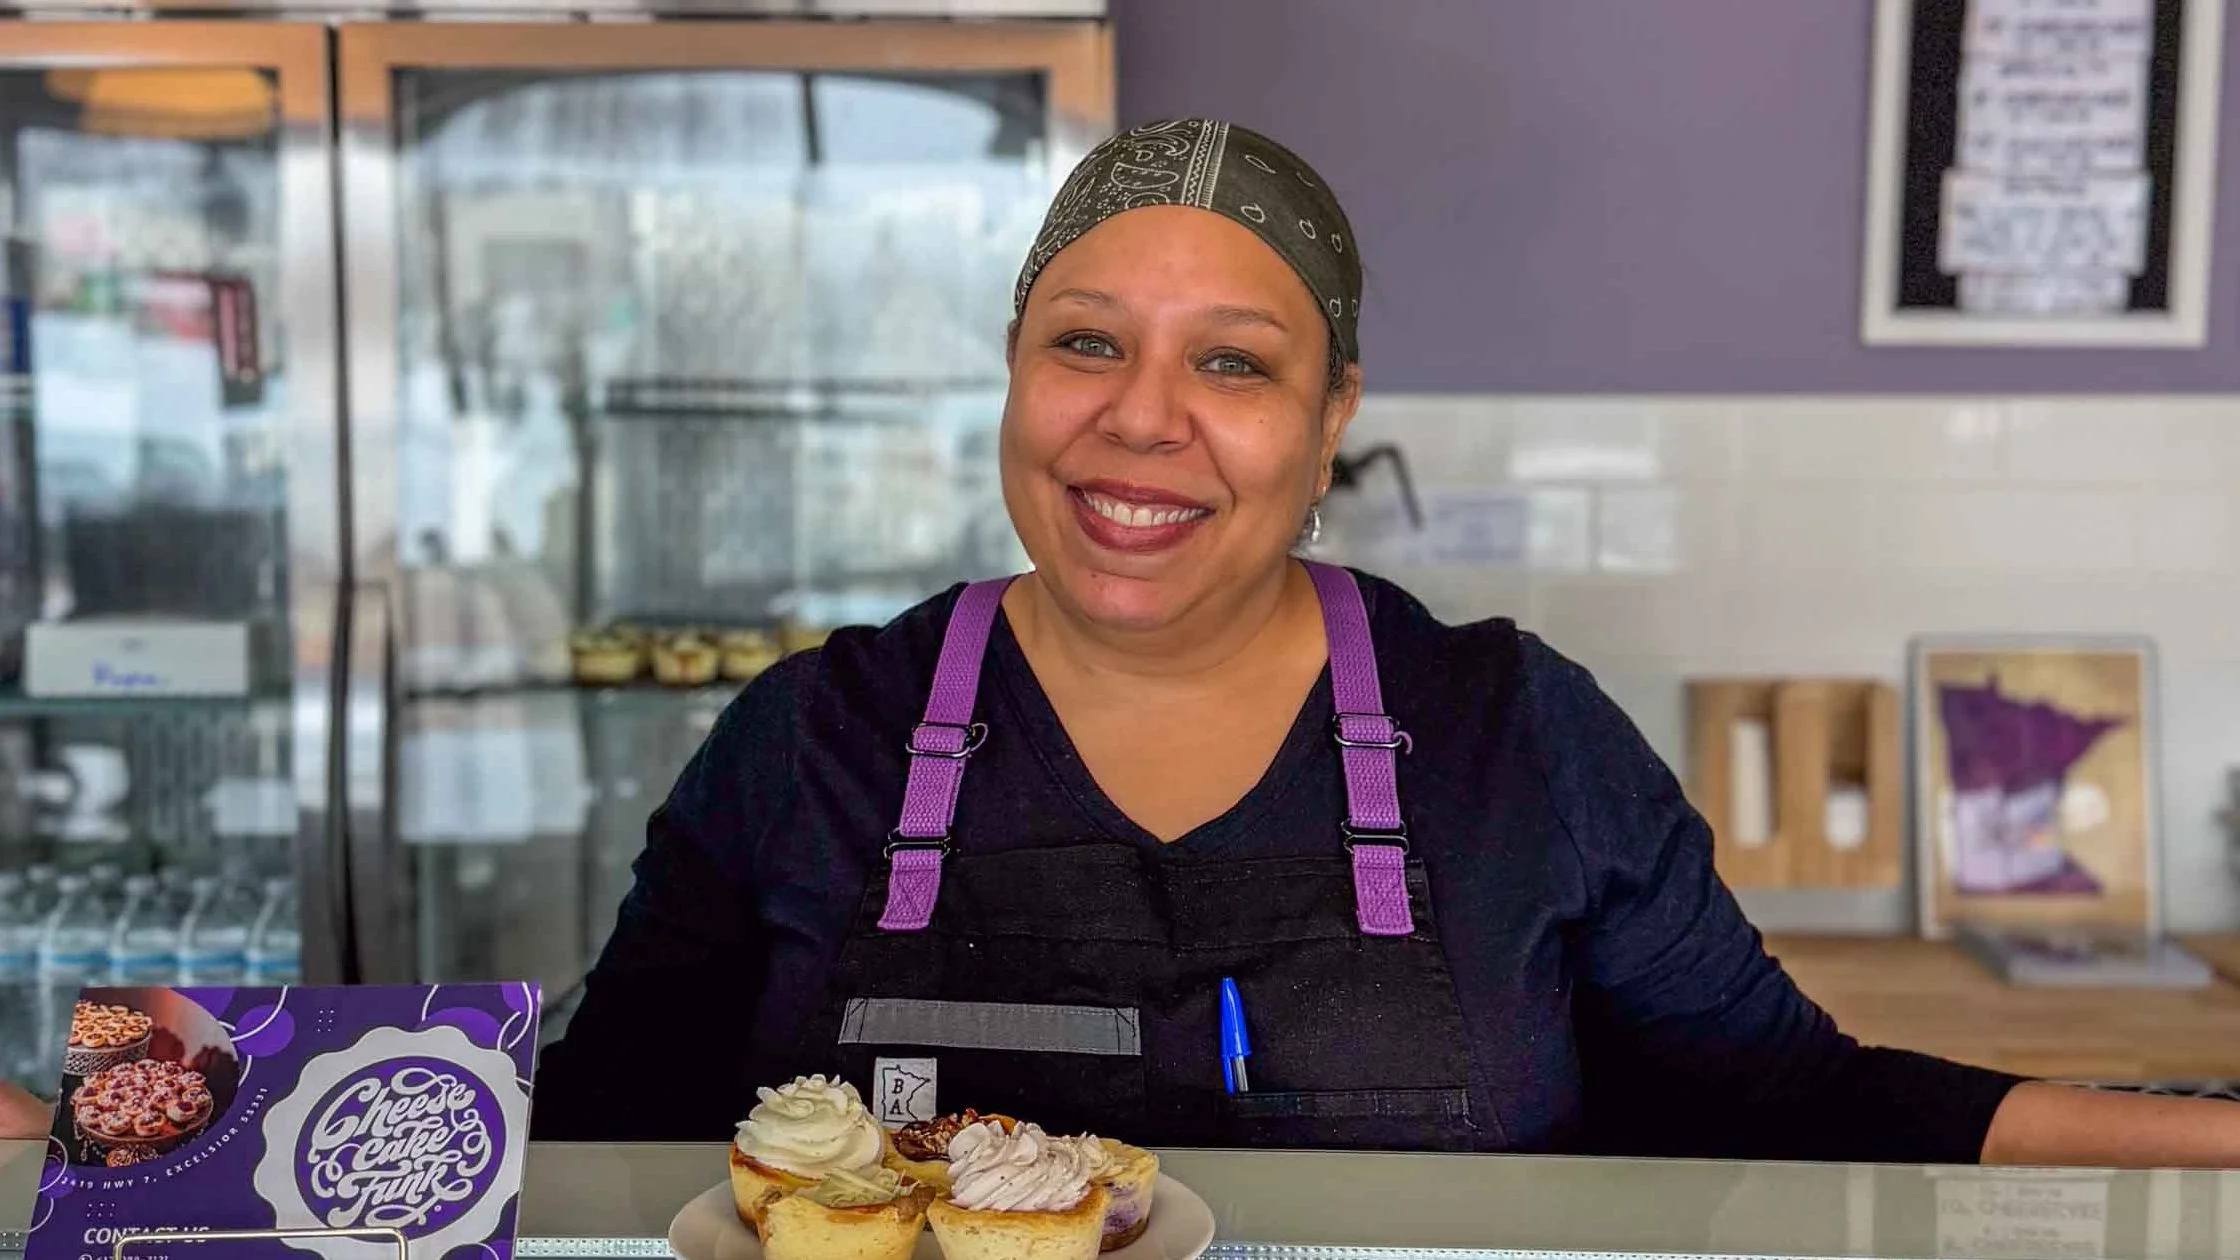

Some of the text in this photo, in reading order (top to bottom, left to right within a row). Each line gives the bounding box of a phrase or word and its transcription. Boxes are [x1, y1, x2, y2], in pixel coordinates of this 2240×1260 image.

[308, 1067, 476, 1156] Cheese
[889, 1098, 905, 1115] A
[892, 1078, 905, 1094] B
[103, 1179, 134, 1190] HWY
[166, 1127, 239, 1177] EXCELSIOR
[352, 1116, 455, 1171] cake
[327, 1150, 473, 1229] Funk
